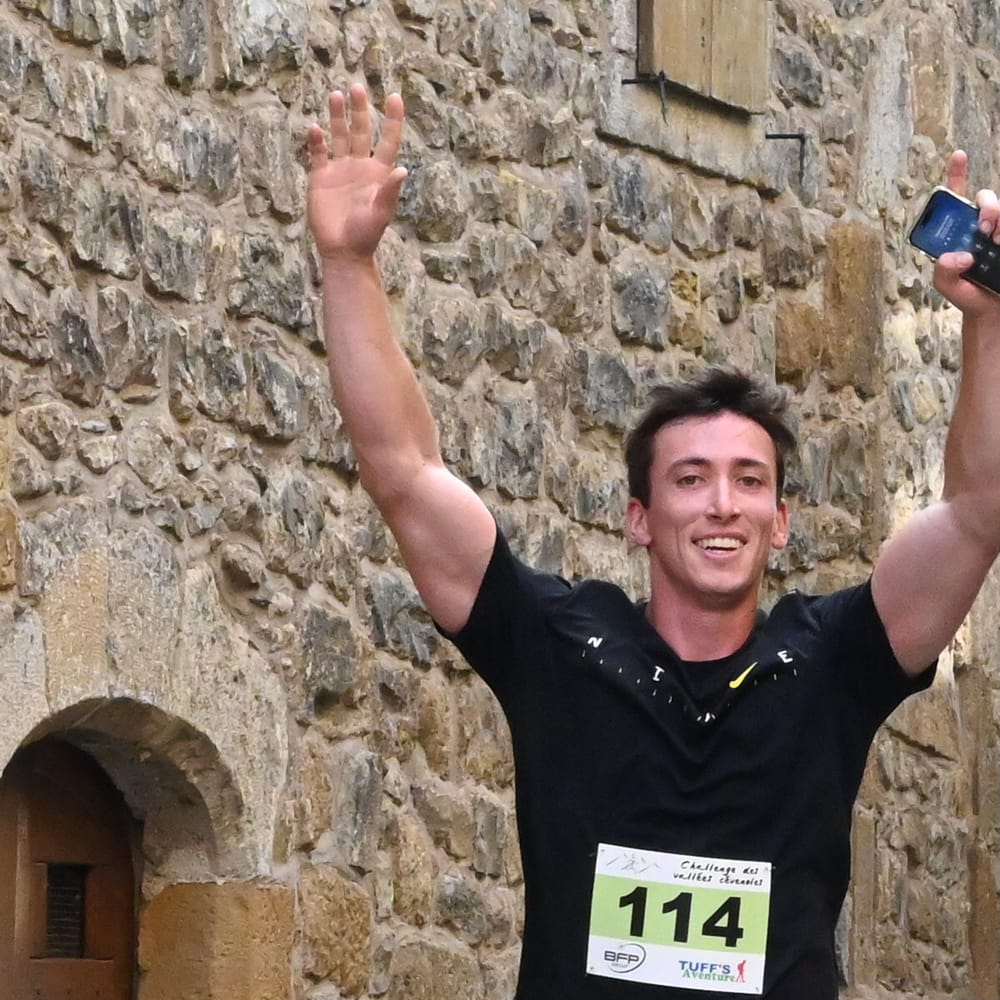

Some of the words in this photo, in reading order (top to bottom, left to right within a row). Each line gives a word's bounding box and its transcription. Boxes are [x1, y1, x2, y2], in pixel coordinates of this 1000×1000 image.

[680, 860, 736, 876] Challenge
[742, 866, 759, 875] des
[673, 871, 713, 882] vallées
[619, 886, 744, 947] 114
[603, 950, 640, 964] BFP
[678, 960, 731, 975] TUFF'S
